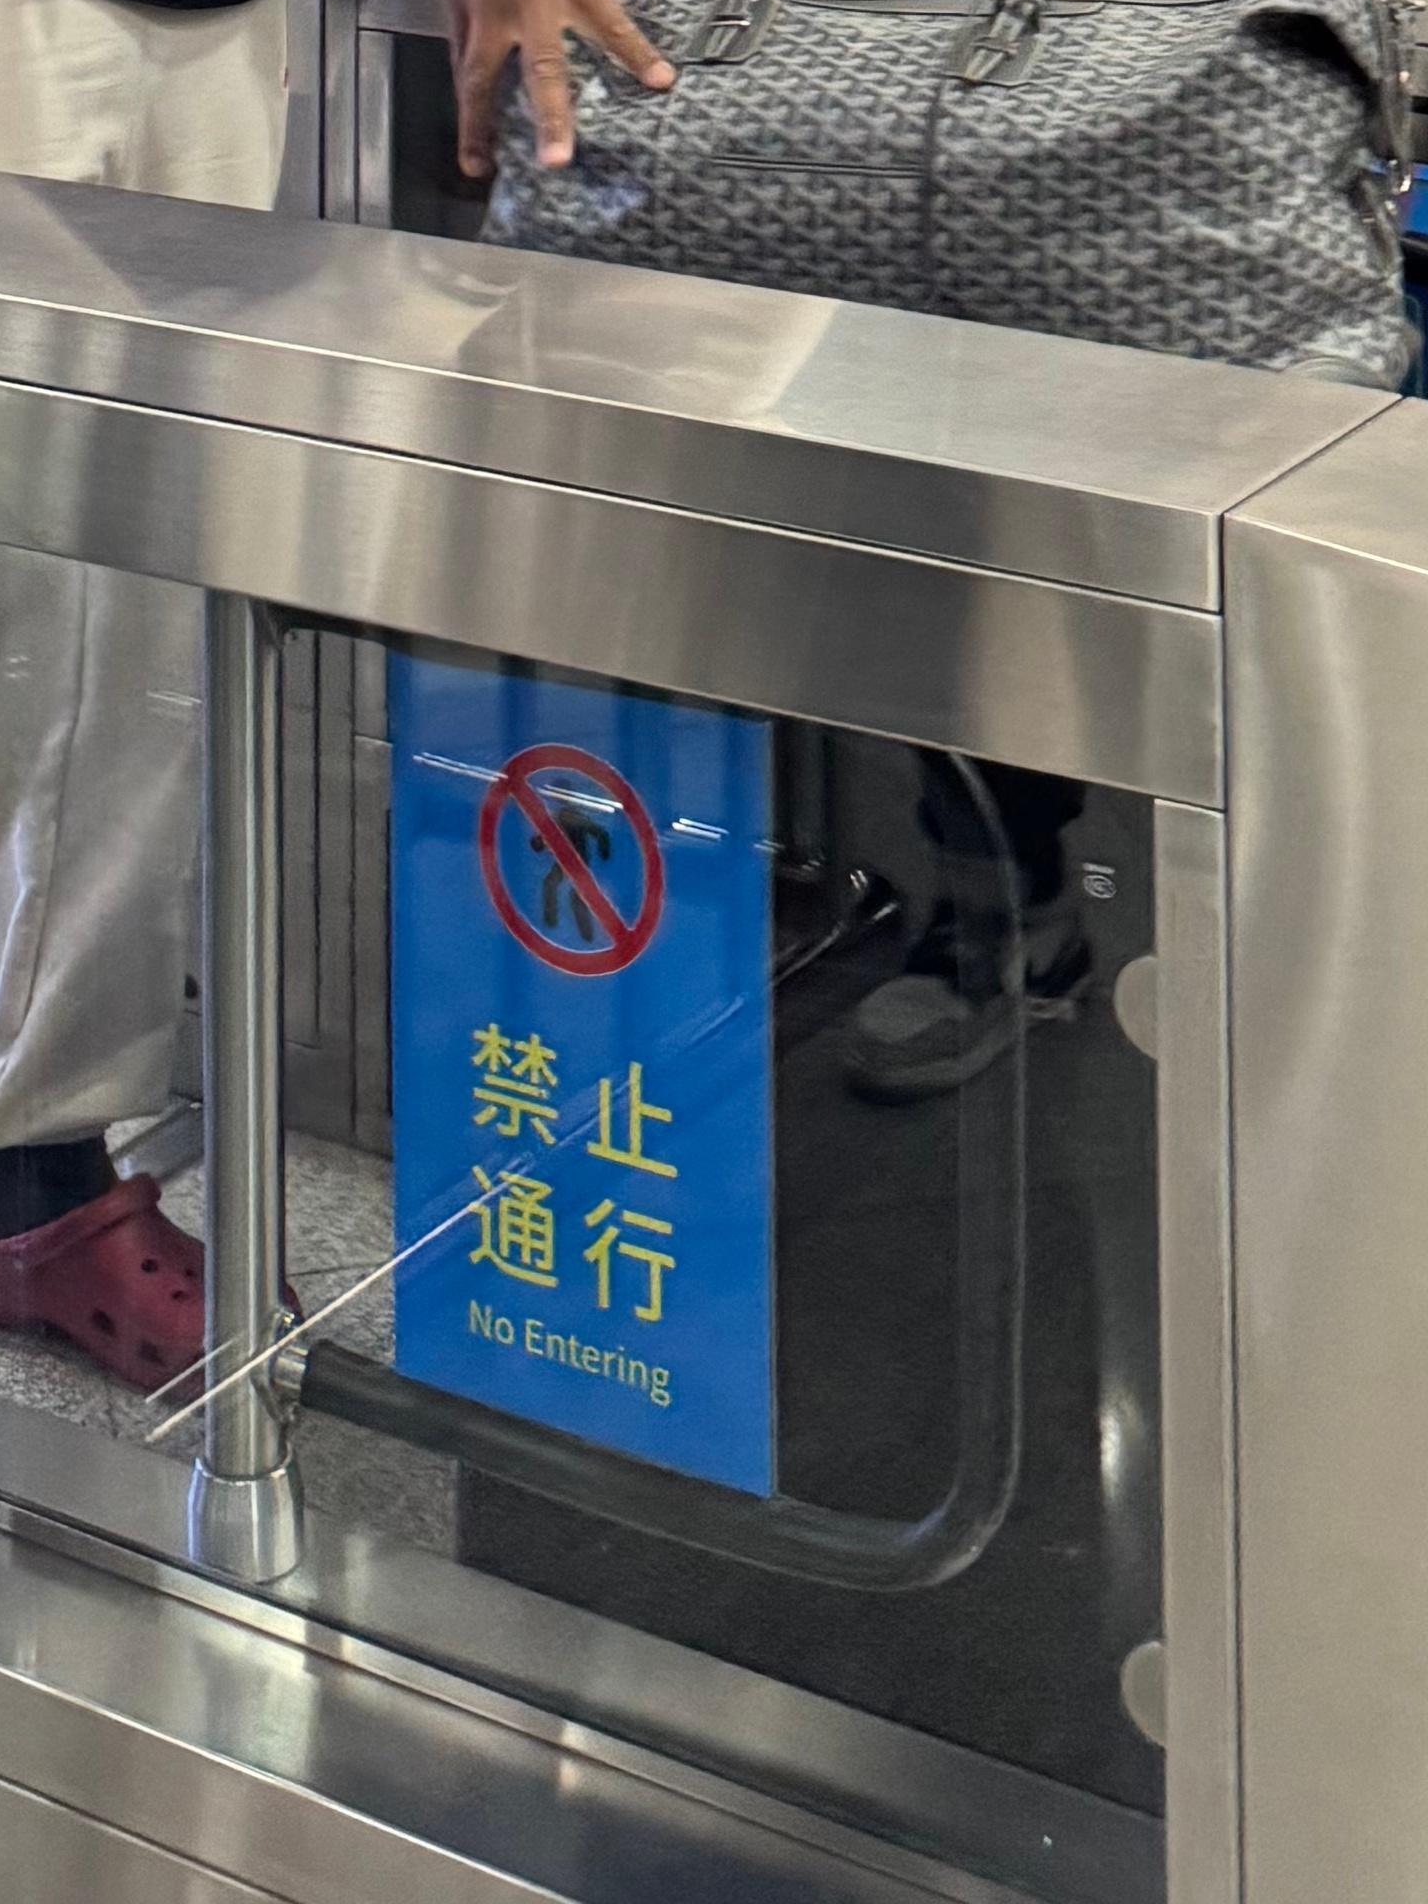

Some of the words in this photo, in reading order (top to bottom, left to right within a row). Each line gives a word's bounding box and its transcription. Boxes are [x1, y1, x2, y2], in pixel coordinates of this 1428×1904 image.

[471, 1022, 678, 1179] 禁止
[469, 1164, 676, 1323] 通行
[469, 1299, 515, 1346] No
[525, 1318, 671, 1408] Entering
